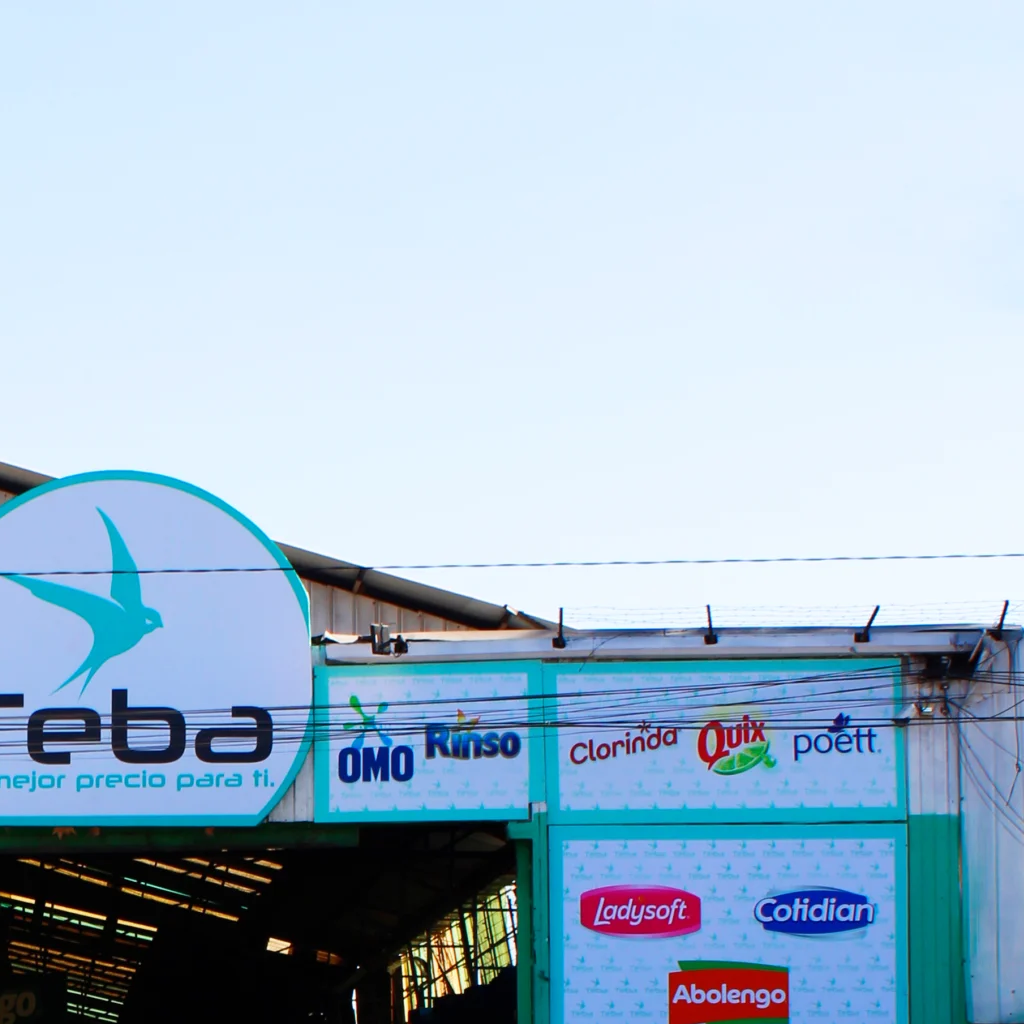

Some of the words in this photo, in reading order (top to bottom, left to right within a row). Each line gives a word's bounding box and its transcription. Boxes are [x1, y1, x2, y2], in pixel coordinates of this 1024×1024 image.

[425, 722, 522, 760] Rinso
[569, 722, 679, 765] Clorinda
[697, 714, 767, 770] Quix
[76, 770, 166, 792] precio
[176, 772, 243, 791] para
[253, 769, 275, 788] ti.
[337, 745, 415, 783] OMO
[593, 897, 688, 926] Ladysoft
[754, 898, 875, 924] Cotidian
[672, 984, 786, 1009] Abolengo
